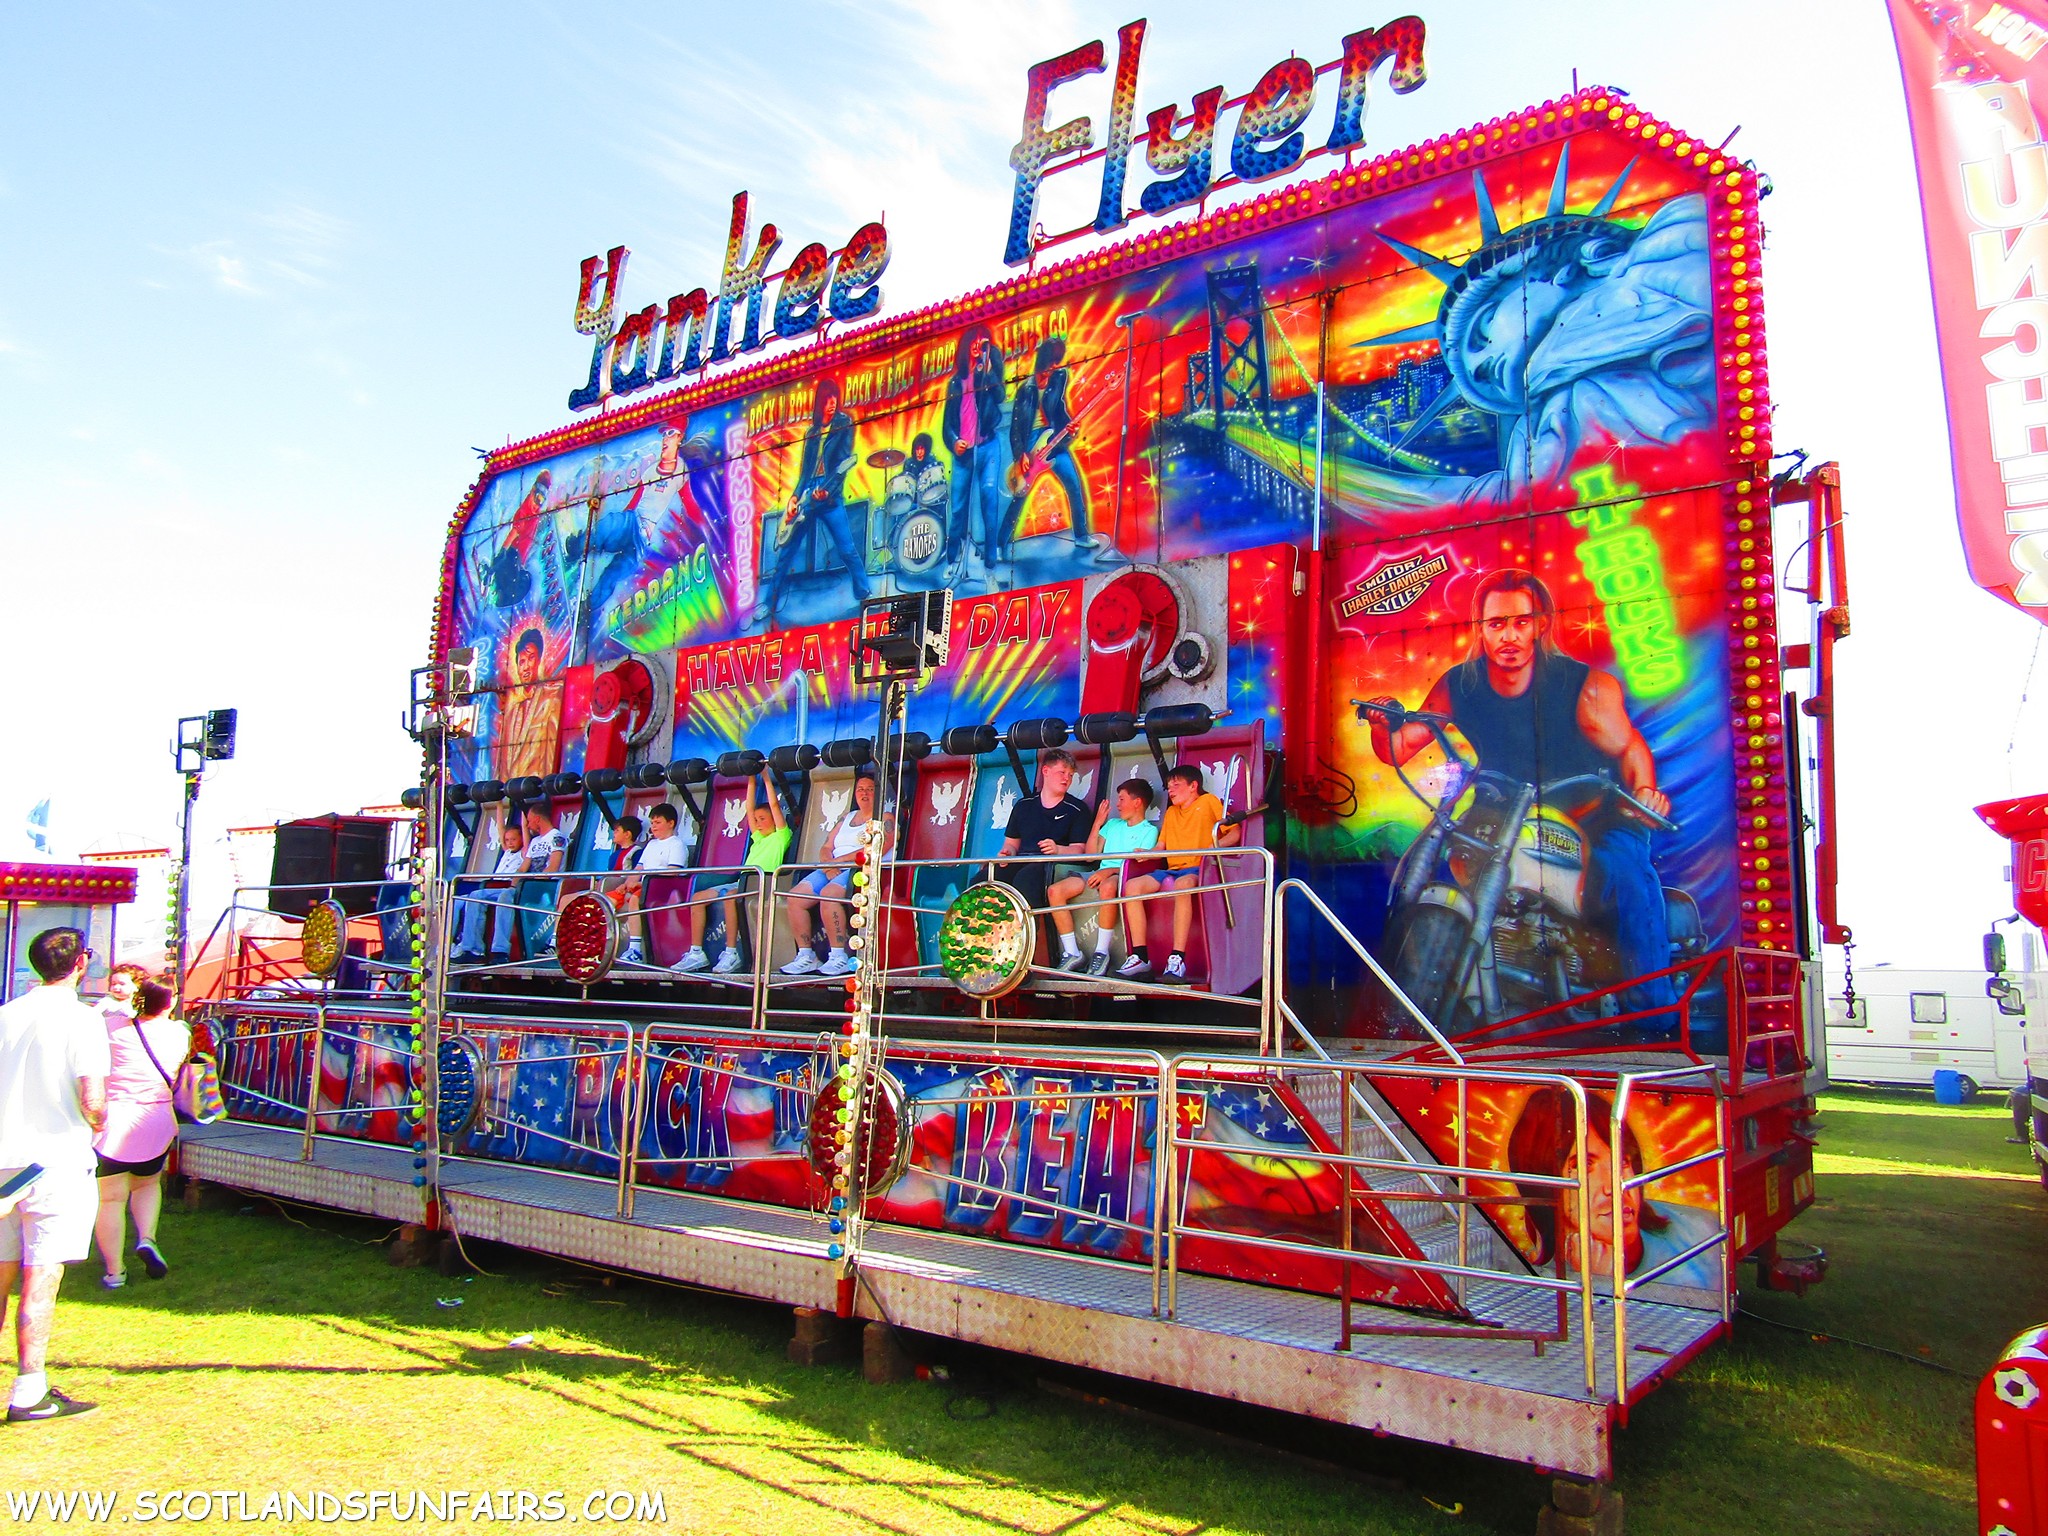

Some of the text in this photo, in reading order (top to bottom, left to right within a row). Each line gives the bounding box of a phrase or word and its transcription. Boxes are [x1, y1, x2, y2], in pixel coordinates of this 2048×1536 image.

[568, 14, 1429, 412] Yankee Flyer
[1049, 308, 1068, 342] GO
[844, 371, 872, 408] ROCK
[888, 358, 914, 396] ROLL
[920, 341, 956, 384] RADIO
[748, 389, 813, 438] ROCK N ROLL
[726, 421, 755, 608] RAMONES
[912, 523, 930, 536] THE
[903, 533, 937, 559] RAMONES
[1365, 559, 1416, 589] MOTOR
[608, 542, 706, 633] KERRANG
[1346, 559, 1442, 613] HARLEY-DAVIDSON
[1373, 584, 1423, 612] CYCLES
[1580, 528, 1684, 693] ROCKS
[687, 638, 783, 694] HAVE
[801, 633, 824, 676] A
[968, 589, 1070, 651] DAY
[568, 1042, 739, 1171] ROCK
[957, 1064, 1208, 1233] BEAT
